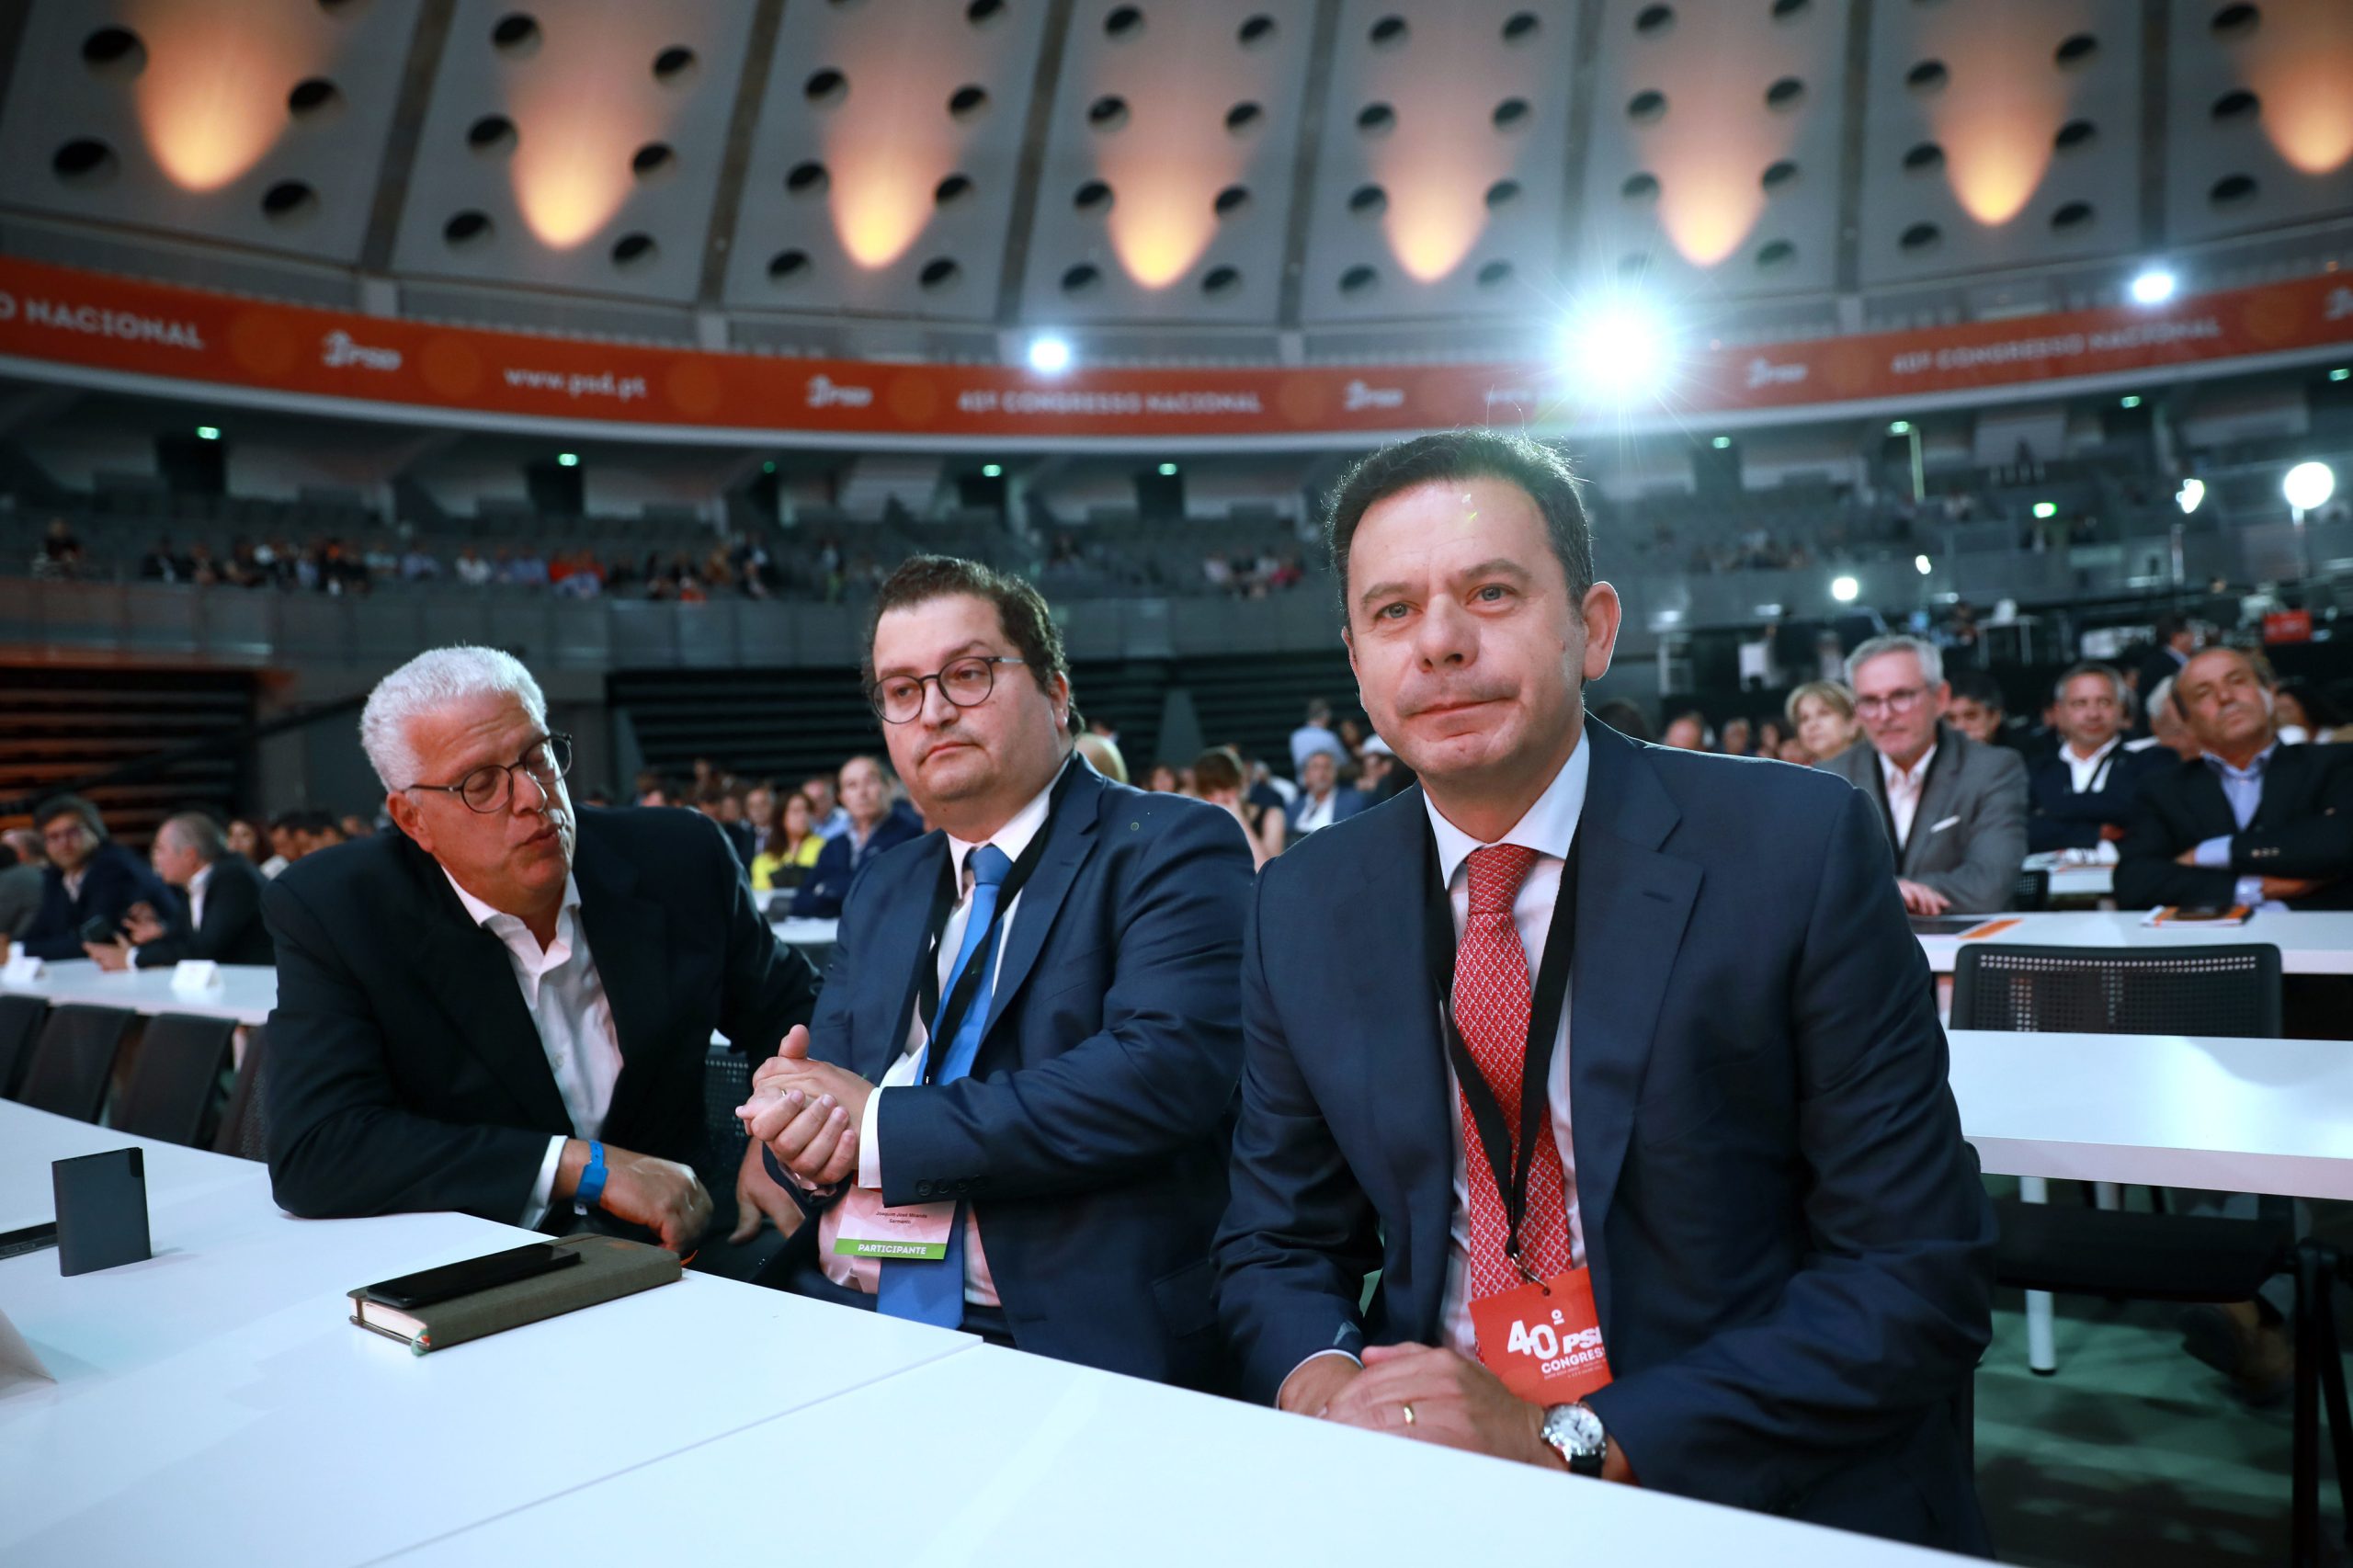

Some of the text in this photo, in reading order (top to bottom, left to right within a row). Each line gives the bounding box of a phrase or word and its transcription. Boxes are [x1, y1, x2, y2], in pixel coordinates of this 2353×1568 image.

[25, 299, 205, 350] NACIONAL
[858, 1244, 926, 1255] PARTICIPANTE
[1540, 1346, 1605, 1374] CONGRES
